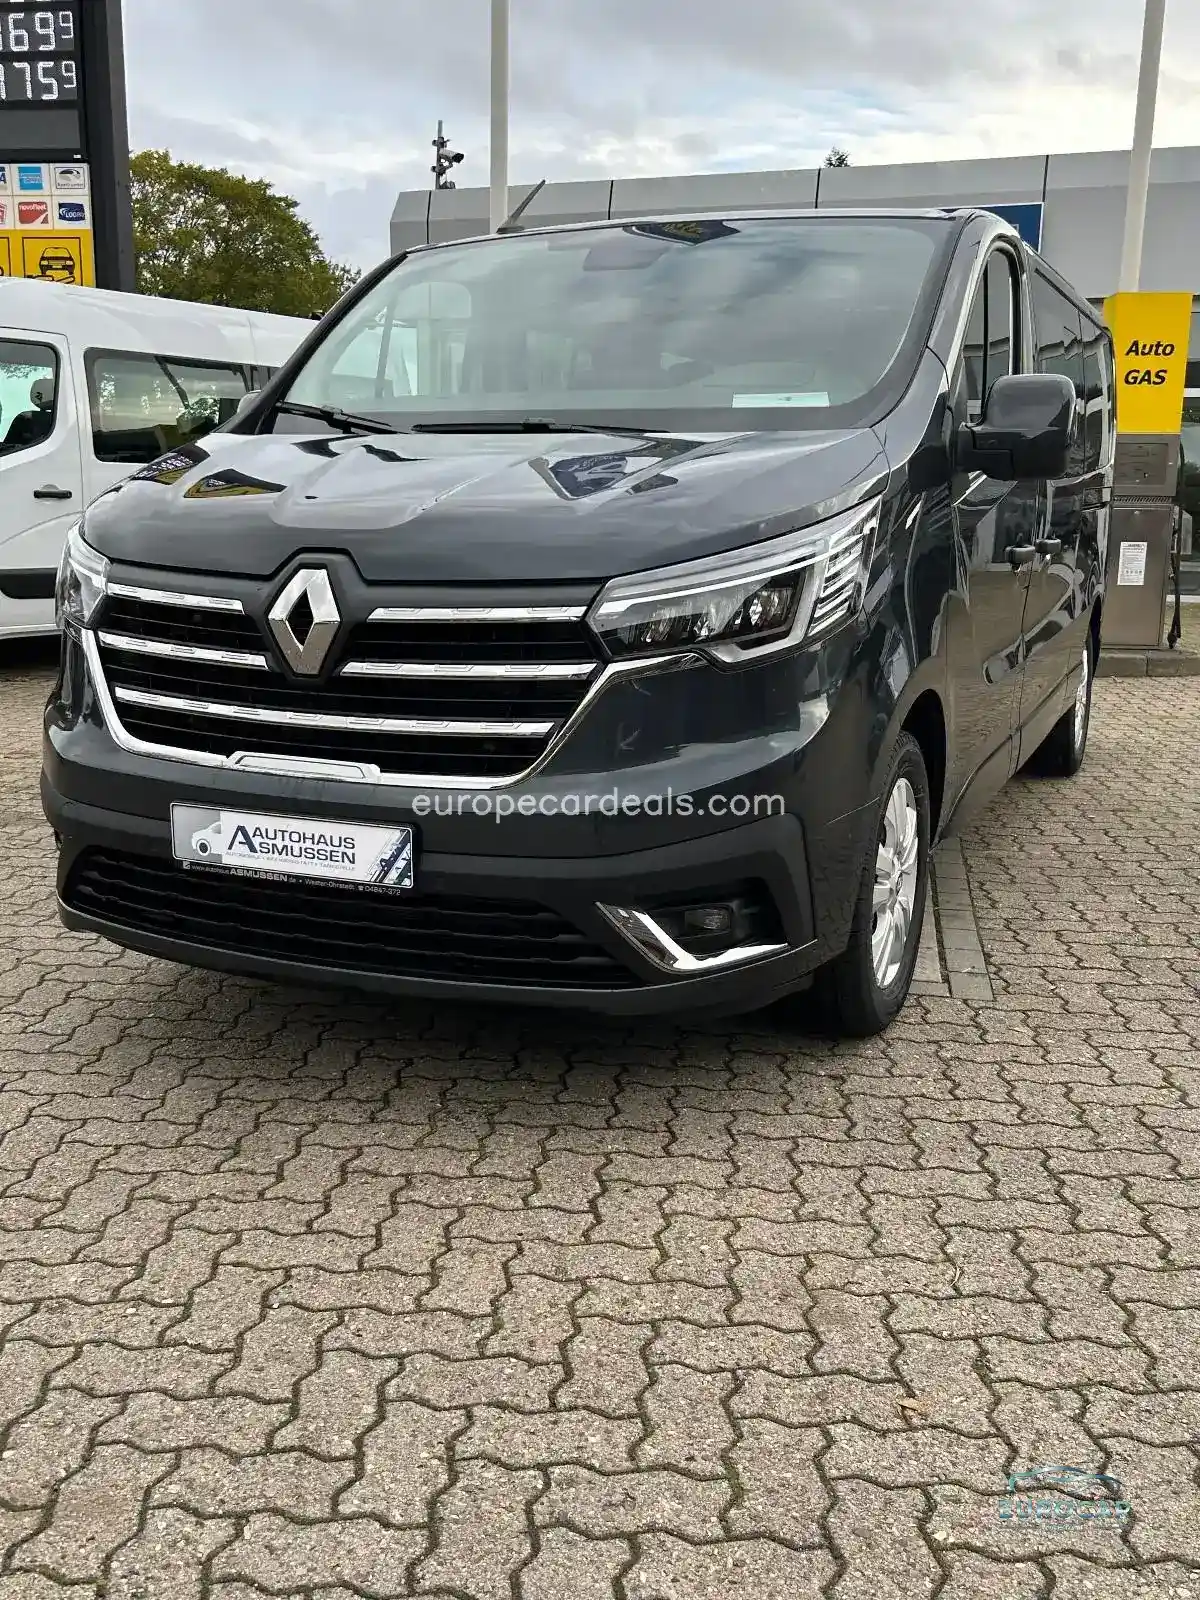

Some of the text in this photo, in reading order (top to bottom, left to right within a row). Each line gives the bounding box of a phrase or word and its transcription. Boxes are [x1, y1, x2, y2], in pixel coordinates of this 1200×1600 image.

[1124, 340, 1175, 356] Auto
[1124, 369, 1168, 385] GAS
[251, 826, 356, 850] AUTOHAUS
